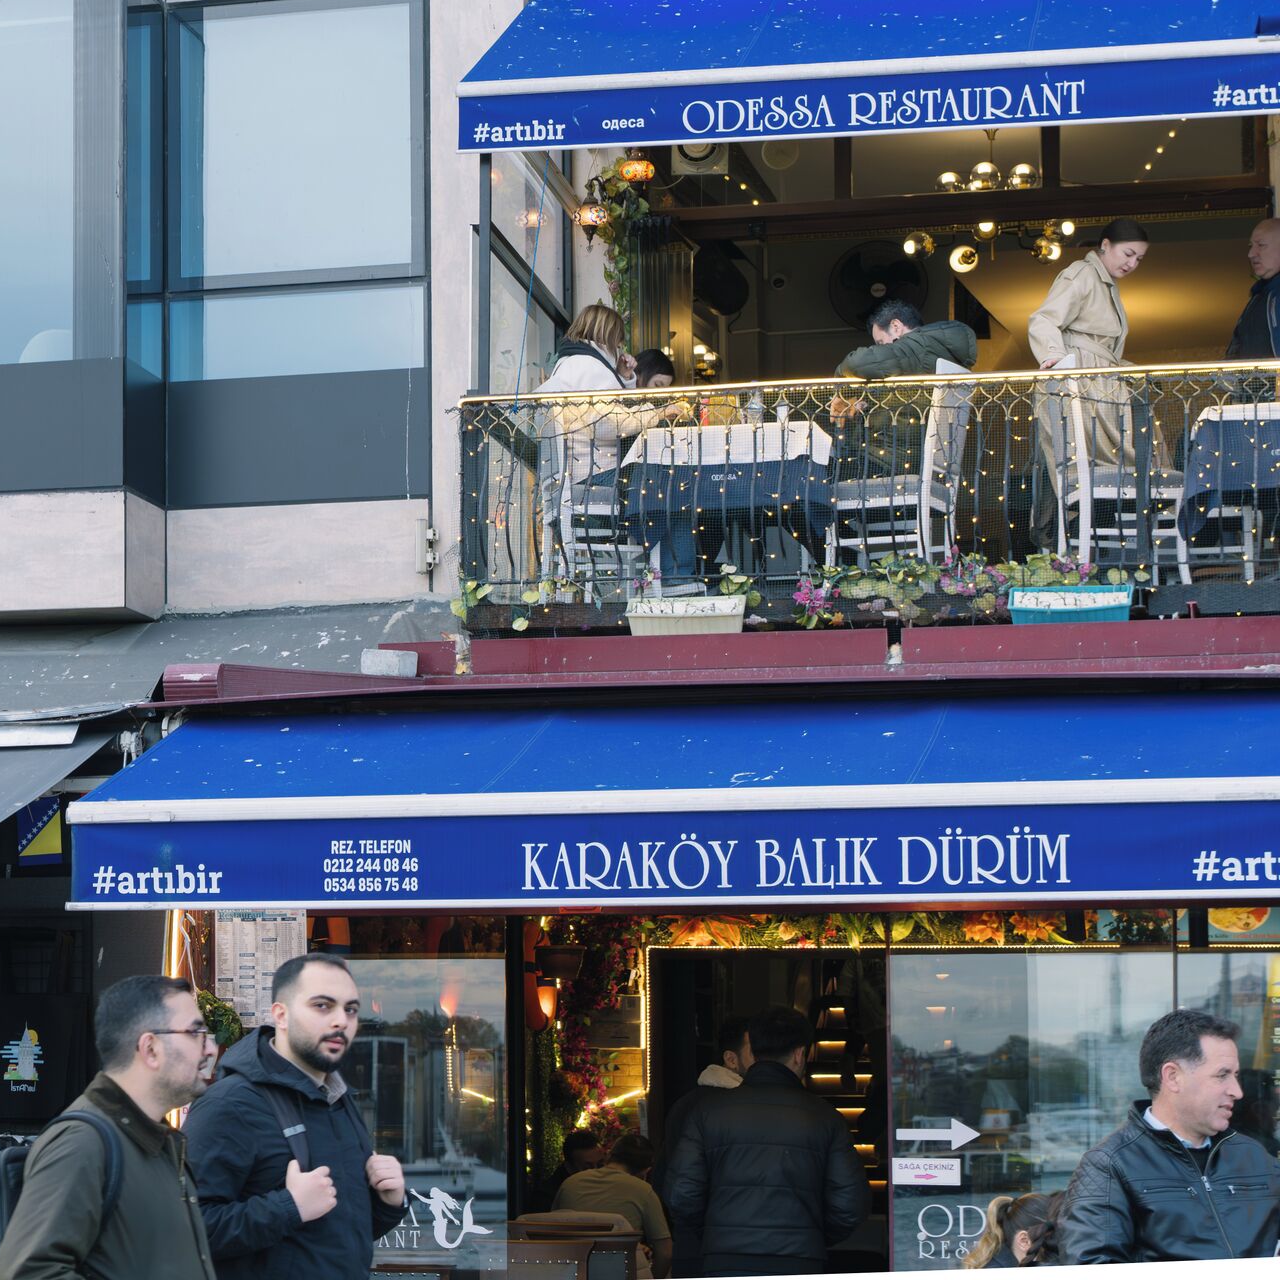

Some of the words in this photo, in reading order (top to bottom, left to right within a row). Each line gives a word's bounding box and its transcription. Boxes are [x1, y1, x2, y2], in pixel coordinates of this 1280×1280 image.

[682, 94, 836, 134] ODESSA
[847, 79, 1086, 126] RESTAURANT
[601, 118, 645, 131] одеса
[331, 840, 357, 854] REZ.
[359, 839, 411, 854] TELEFON
[323, 858, 354, 873] 0212
[355, 858, 381, 873] 244
[383, 858, 400, 872] 08
[401, 857, 419, 872] 46
[521, 832, 739, 890] KARAKÖY
[755, 837, 881, 890] BALIK
[897, 826, 1071, 886] DÜRÜM
[324, 877, 356, 892] 0534
[358, 877, 382, 892] 856
[384, 877, 400, 892] 75
[401, 876, 419, 892] 48
[923, 1163, 955, 1172] ÇEKİNİZ
